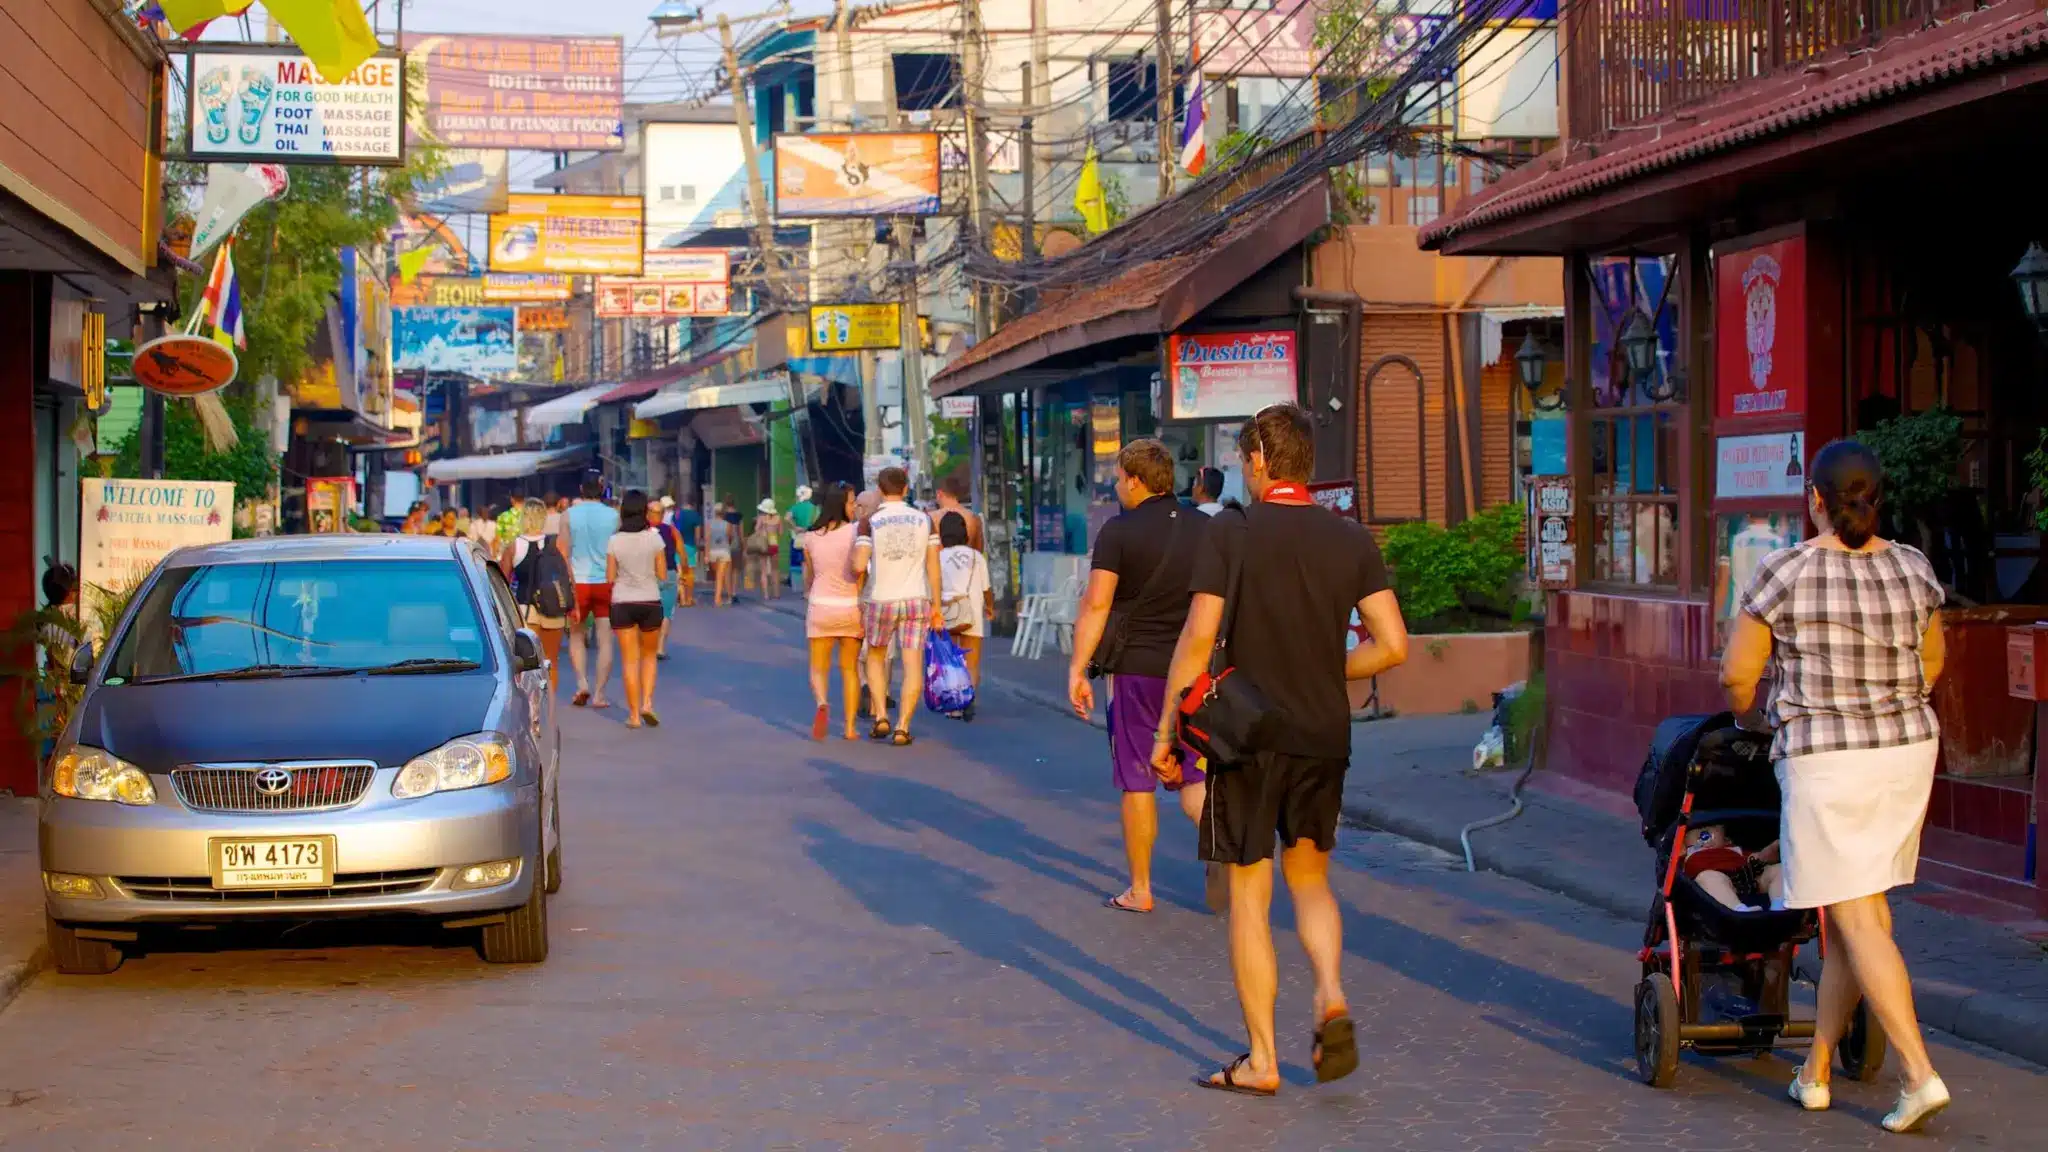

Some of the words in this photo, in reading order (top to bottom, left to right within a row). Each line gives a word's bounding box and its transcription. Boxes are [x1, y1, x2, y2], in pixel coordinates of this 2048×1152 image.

[1197, 12, 1301, 48] BAR
[277, 61, 395, 87] MAAGE
[488, 73, 547, 91] HOTEL
[563, 75, 617, 92] GRILL
[276, 90, 300, 102] FOR
[304, 91, 340, 103] GOOD
[344, 93, 394, 105] HEALTH
[275, 107, 313, 120] FOOT
[323, 109, 393, 121] MASSAGE
[489, 116, 508, 131] DE
[275, 123, 309, 136] THAI
[322, 125, 392, 138] MASSAGE
[275, 139, 299, 151] OIL
[322, 140, 391, 153] MASSAGE
[1180, 339, 1286, 363] Dusita's
[103, 485, 188, 507] WELCOME
[194, 488, 216, 509] TO
[265, 843, 319, 866] 4173
